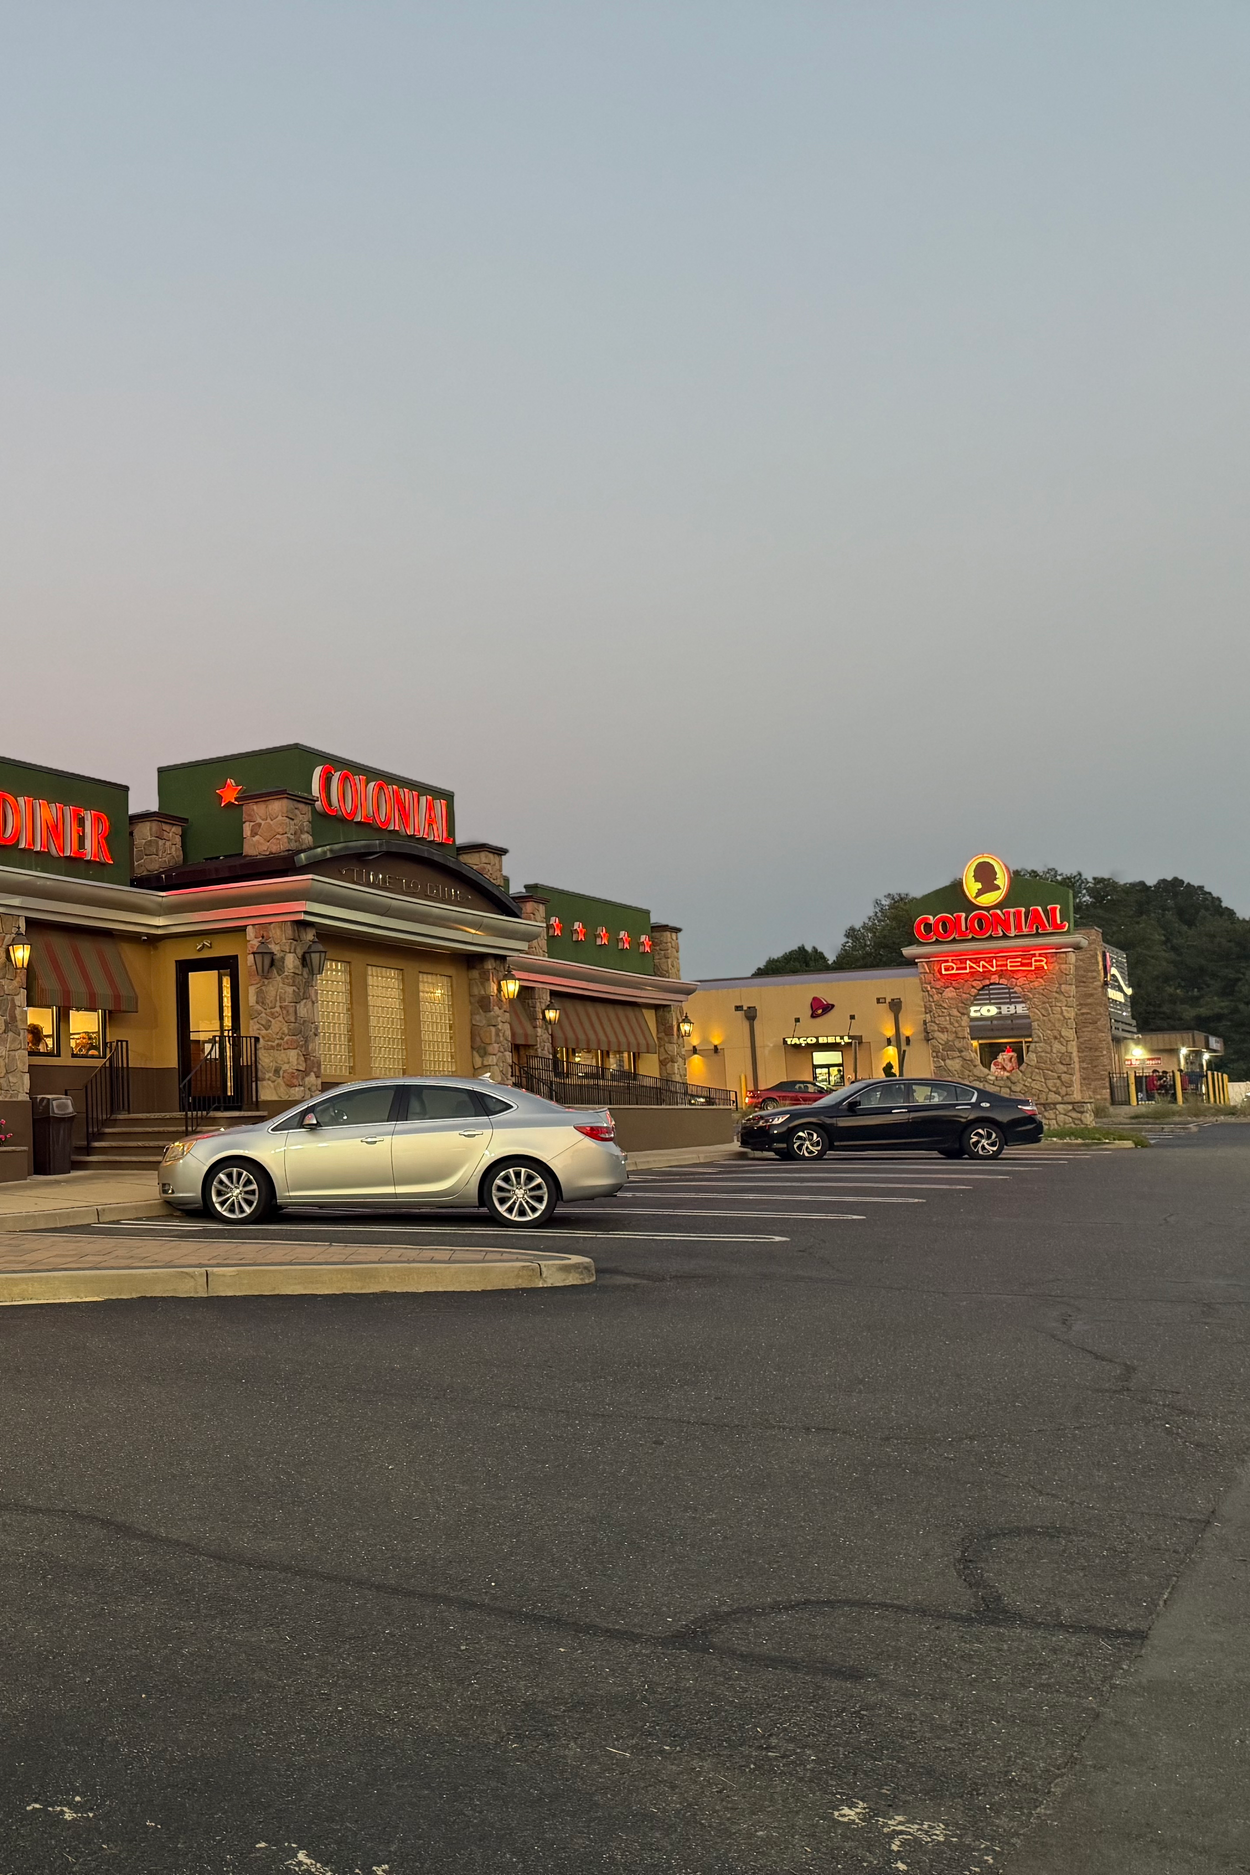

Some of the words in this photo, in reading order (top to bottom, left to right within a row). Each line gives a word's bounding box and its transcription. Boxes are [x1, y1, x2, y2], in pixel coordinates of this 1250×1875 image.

[311, 764, 454, 844] COLONIAL
[914, 905, 1069, 943] COLONIAL
[969, 1005, 998, 1016] CO
[785, 1036, 817, 1045] TACO
[818, 1035, 852, 1044] BELL
